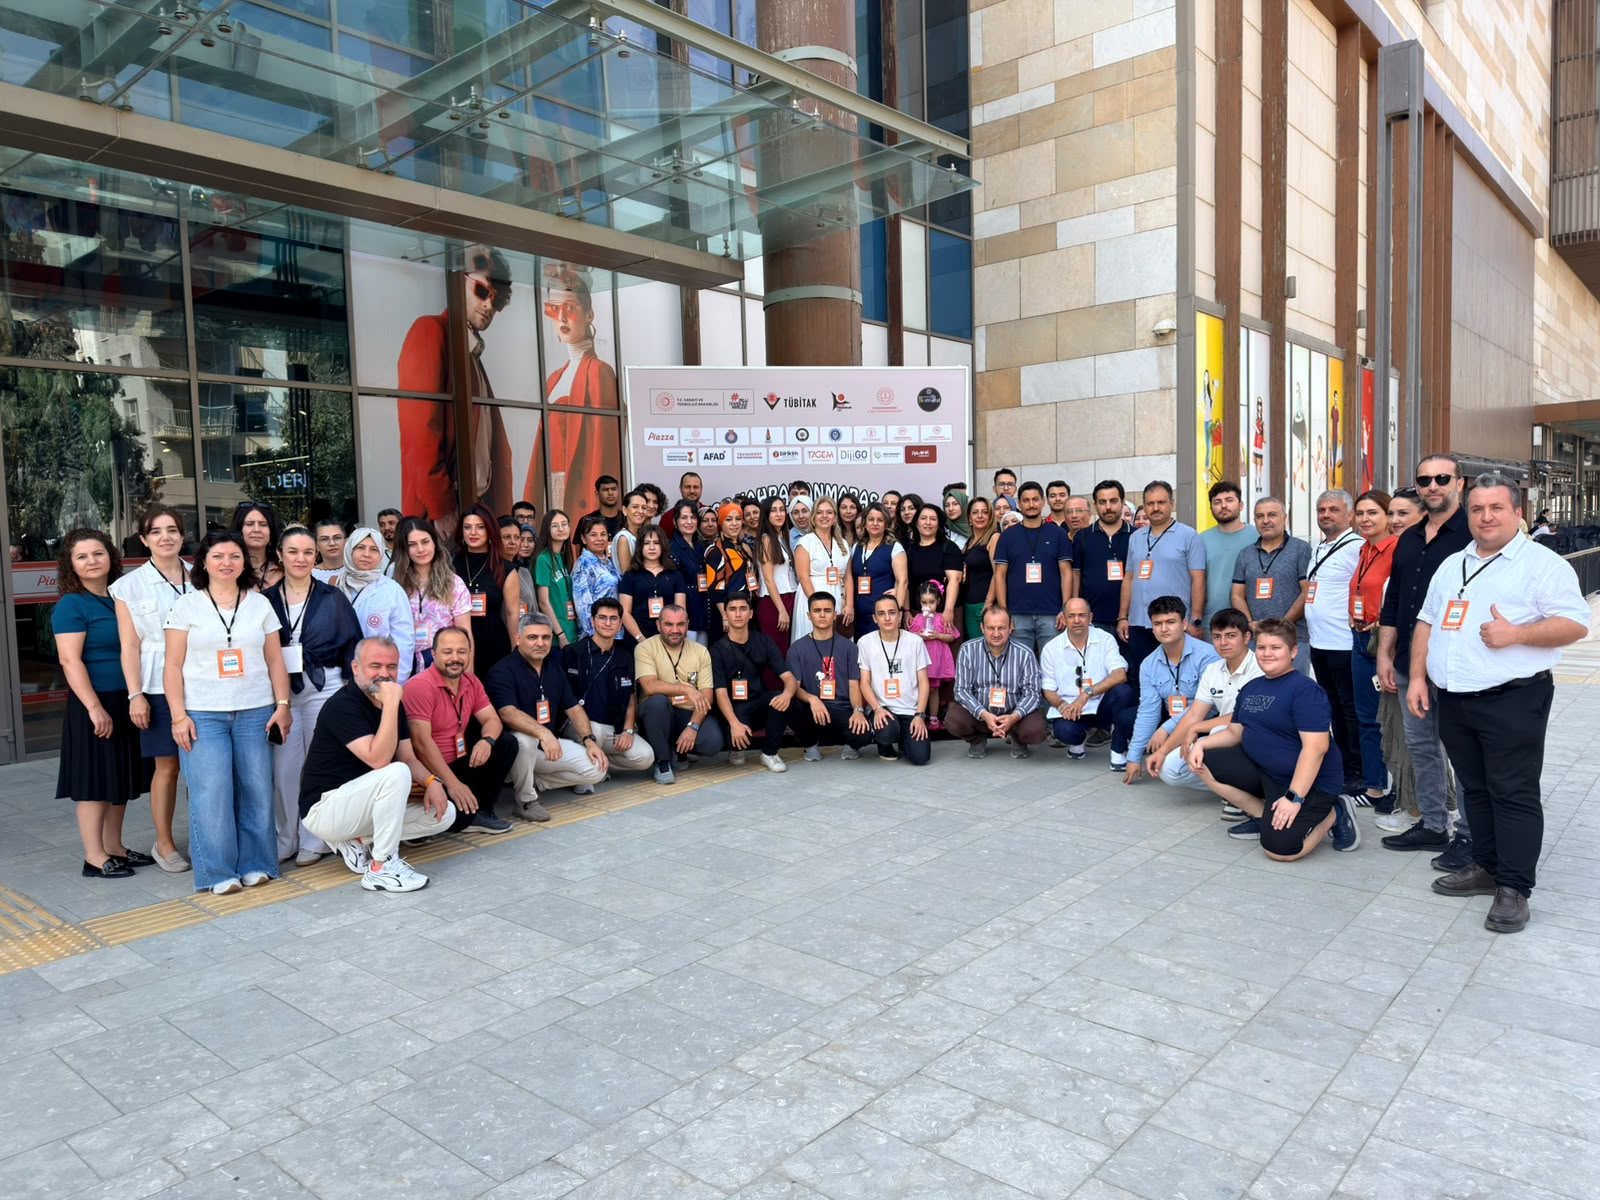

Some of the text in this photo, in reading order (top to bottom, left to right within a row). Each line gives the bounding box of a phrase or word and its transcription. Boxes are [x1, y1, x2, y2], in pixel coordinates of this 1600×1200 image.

[784, 397, 817, 408] TÜBİTAK
[648, 432, 674, 441] Piazza
[703, 452, 725, 461] AFAD
[808, 451, 834, 459] TAGEM
[840, 450, 868, 461] DijiGO
[37, 575, 57, 587] Pia
